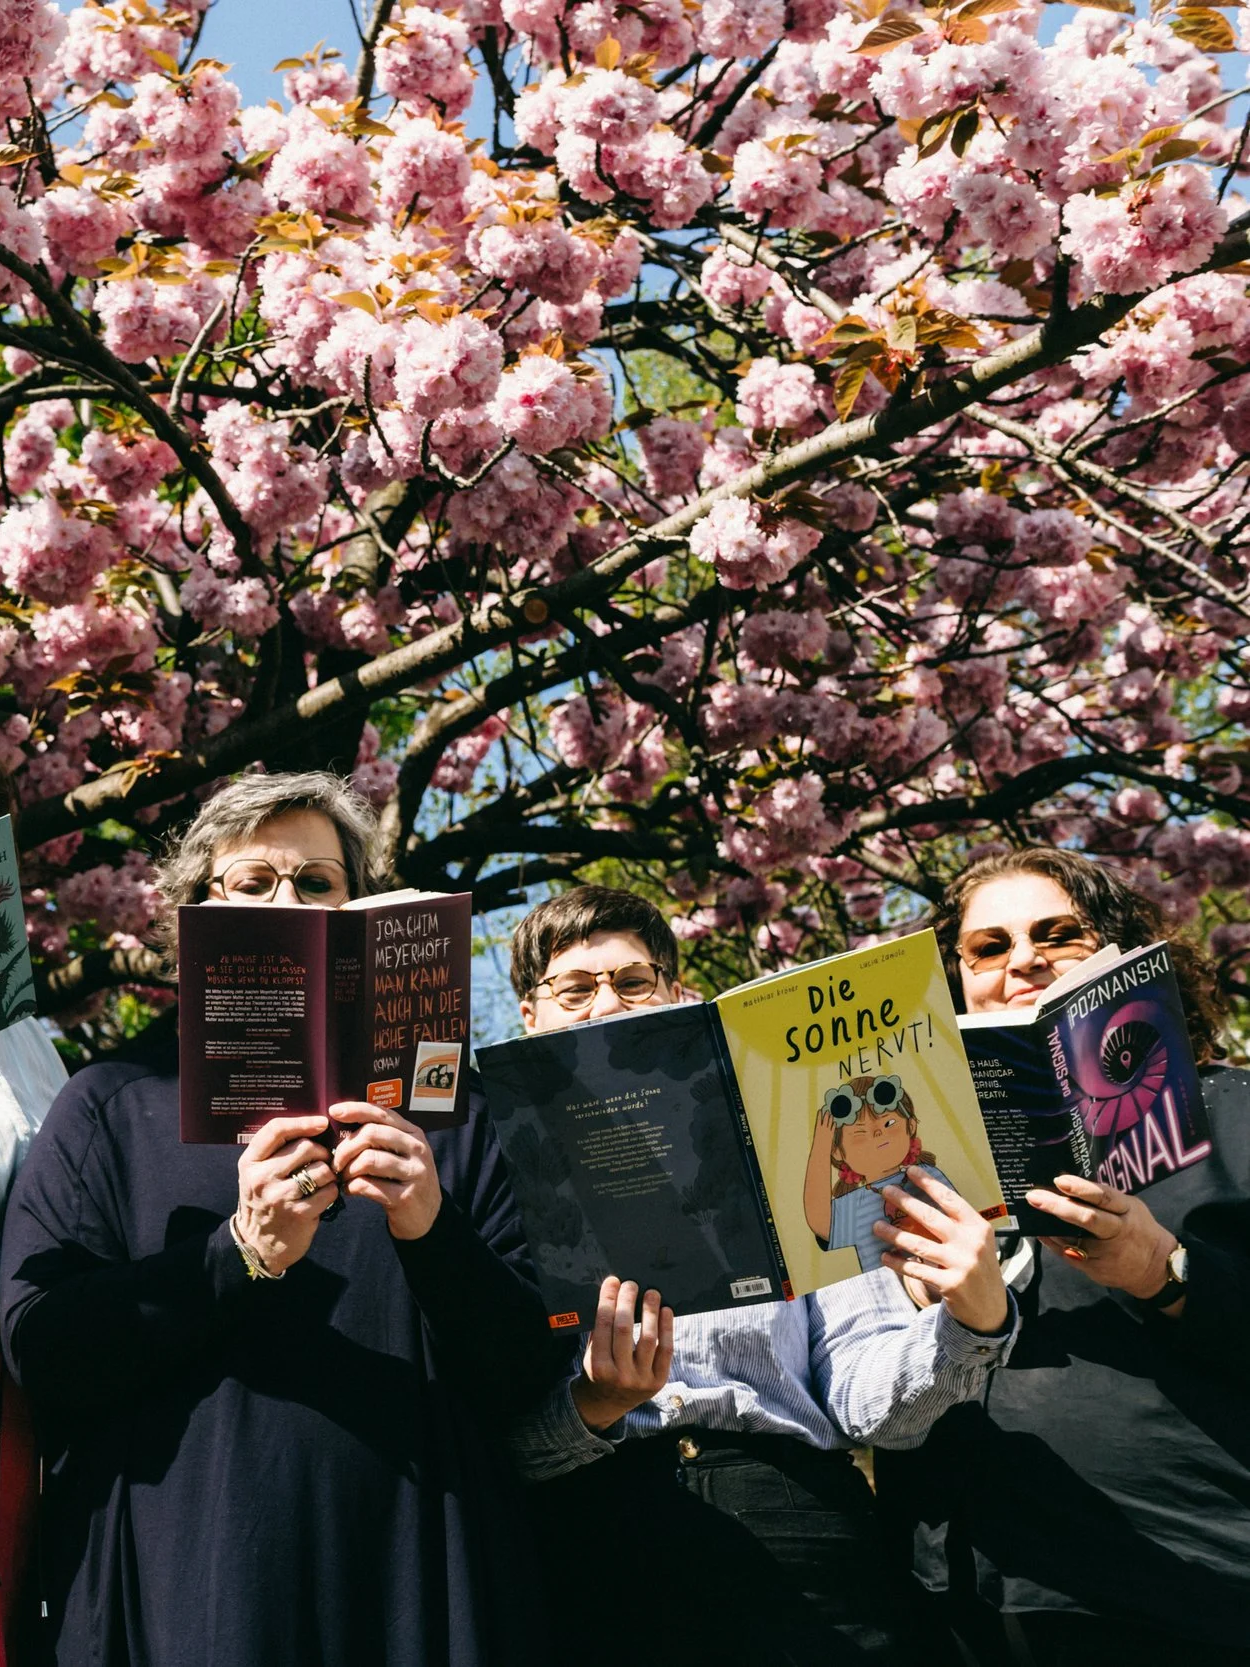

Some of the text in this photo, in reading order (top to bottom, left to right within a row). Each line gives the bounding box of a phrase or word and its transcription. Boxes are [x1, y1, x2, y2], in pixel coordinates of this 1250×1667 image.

[376, 912, 440, 942] JOACHIM
[375, 937, 452, 970] MEYERHOFF
[374, 973, 406, 997] MAN
[410, 963, 450, 993] KANN
[808, 975, 855, 1014] Die
[1068, 951, 1170, 1030] POZNANSKI
[374, 988, 463, 1024] AUCH IN DIE
[373, 1017, 469, 1053] HÖHE FALLEN
[839, 1013, 933, 1079] NERVT!
[373, 1056, 402, 1073] ROMAN
[972, 1069, 1015, 1078] HANDICAP.
[977, 1059, 1003, 1068] HAUS.
[1046, 1025, 1072, 1098] DAS SIGNAL
[974, 1080, 1002, 1089] ORNIG.
[977, 1090, 1008, 1099] REATIV.
[1069, 1106, 1093, 1178] POZNANSKI
[1069, 1129, 1081, 1167] URSULA
